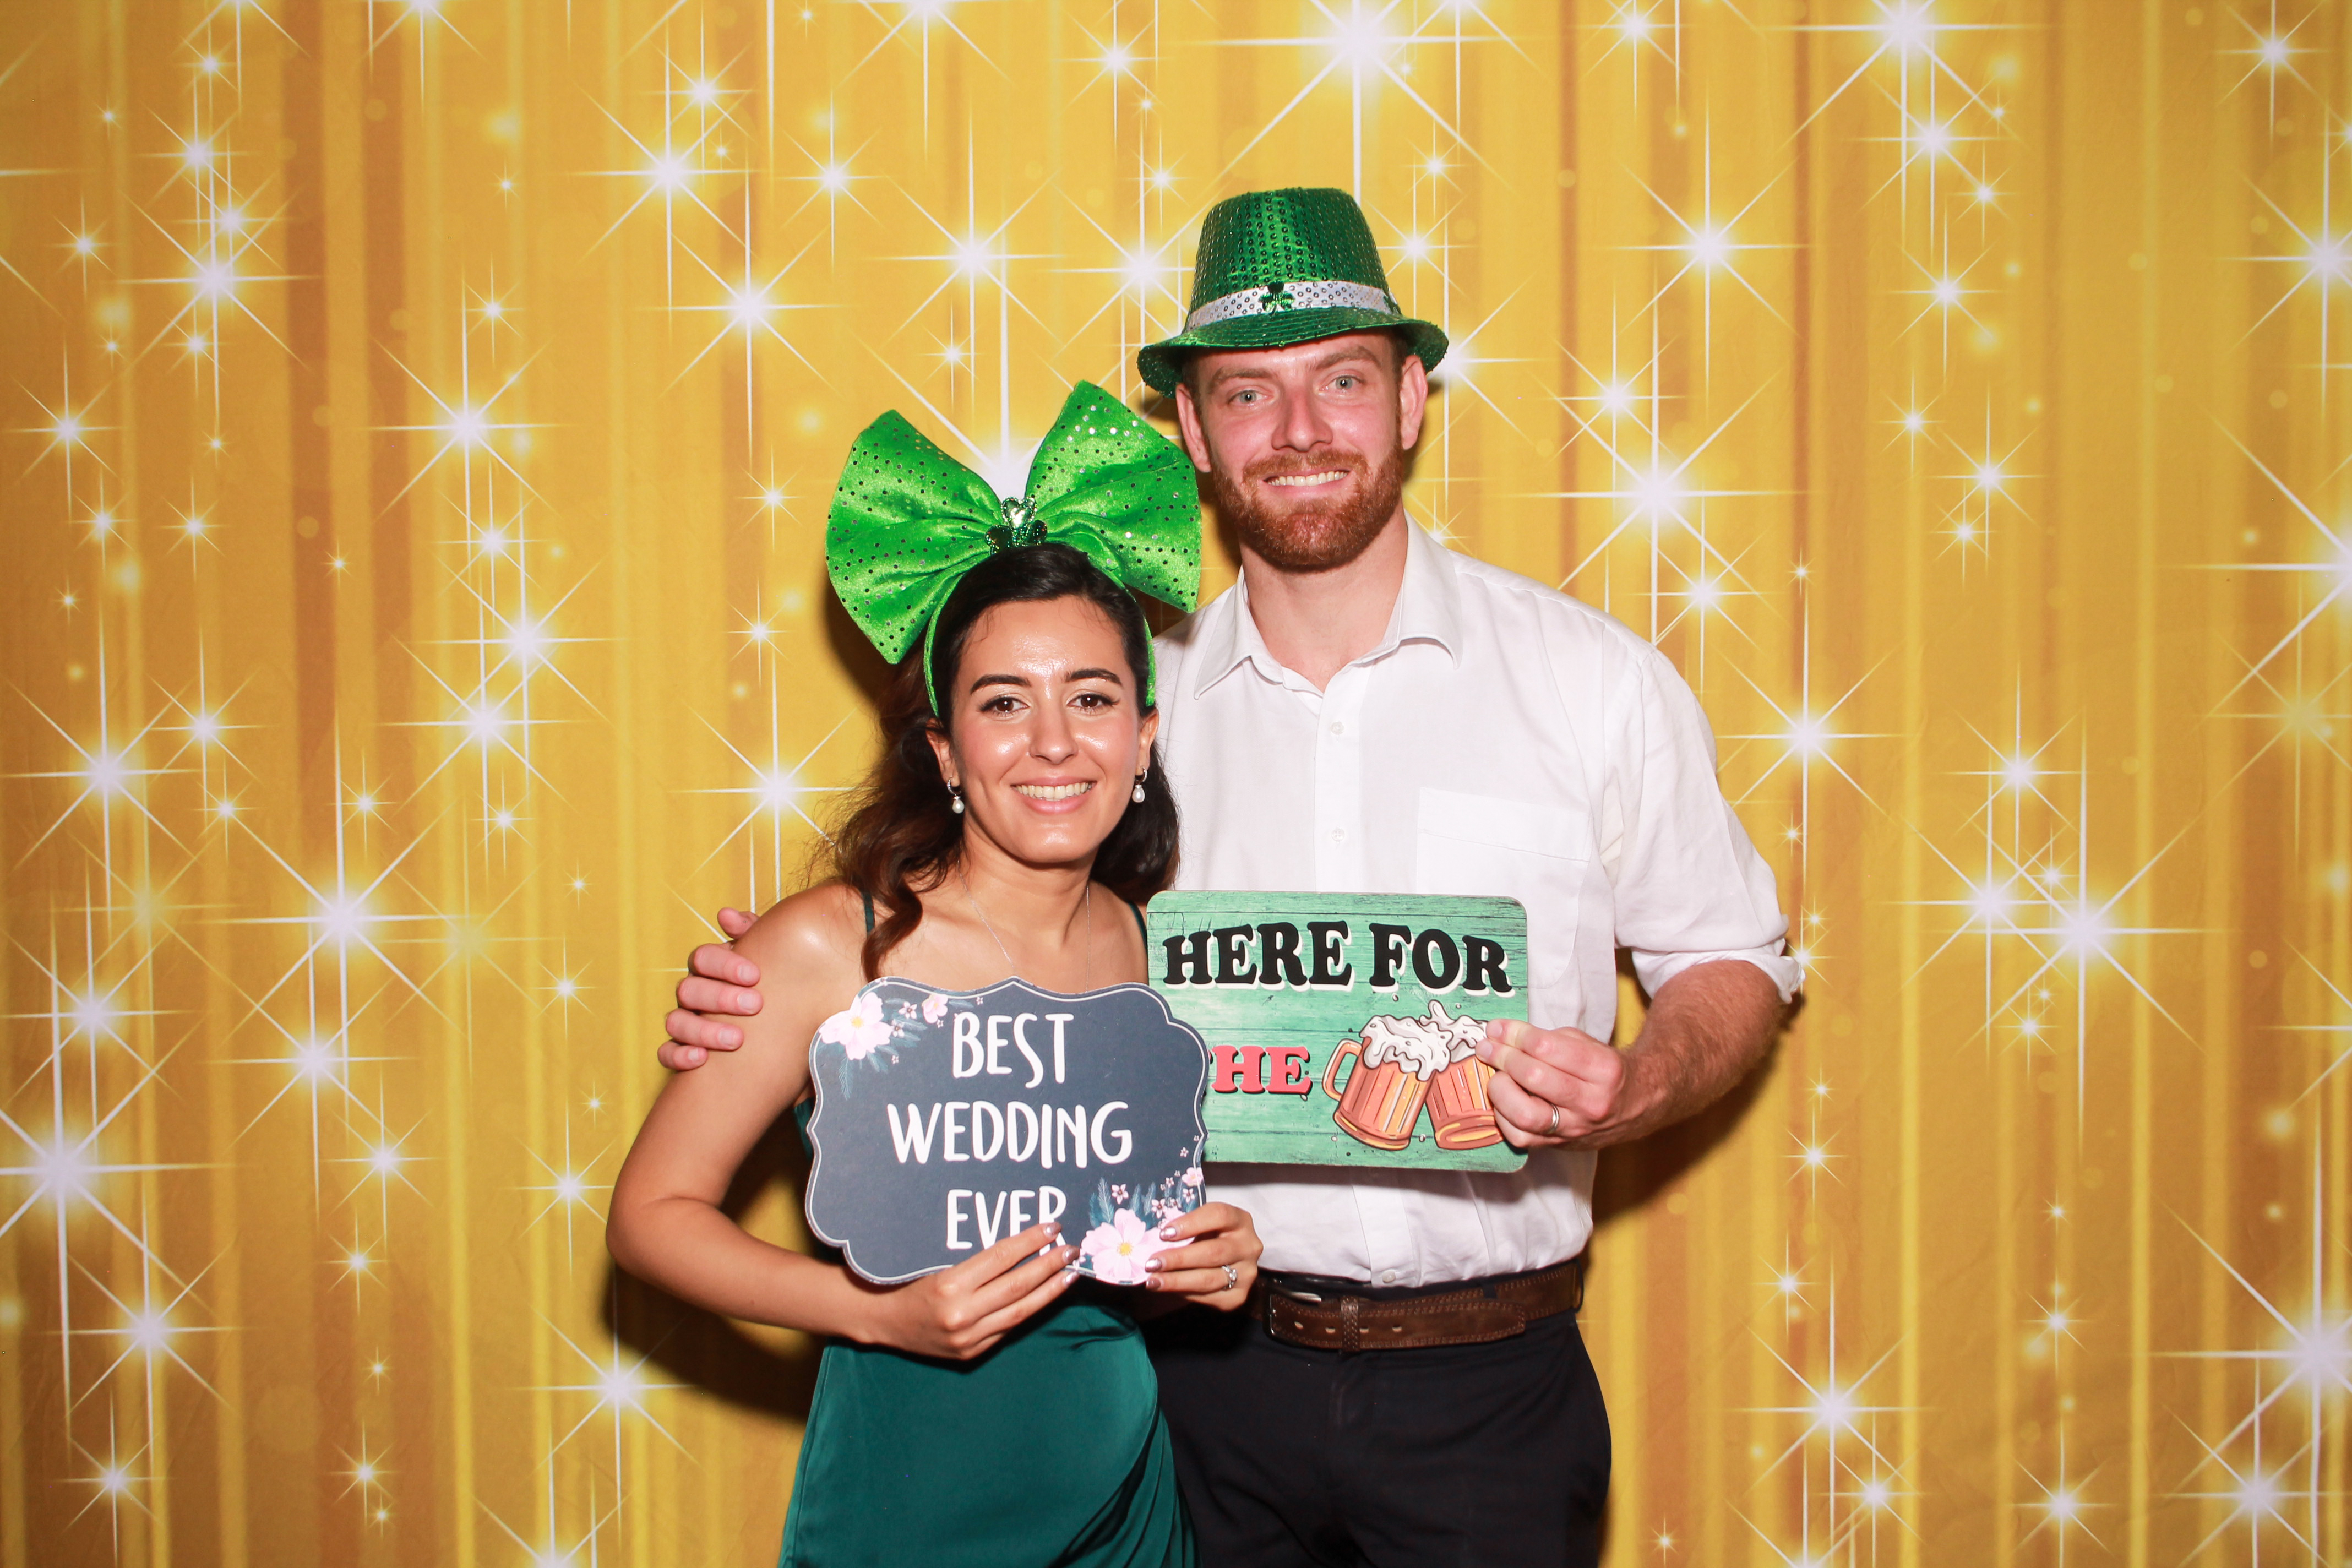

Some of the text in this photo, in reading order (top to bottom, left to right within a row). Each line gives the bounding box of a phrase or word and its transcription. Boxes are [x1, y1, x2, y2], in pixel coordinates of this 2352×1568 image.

[1162, 920, 1516, 998] HERE FOR
[952, 1011, 1075, 1089] BEST
[1208, 1044, 1314, 1095] HE
[886, 1101, 1133, 1169] WEDDING
